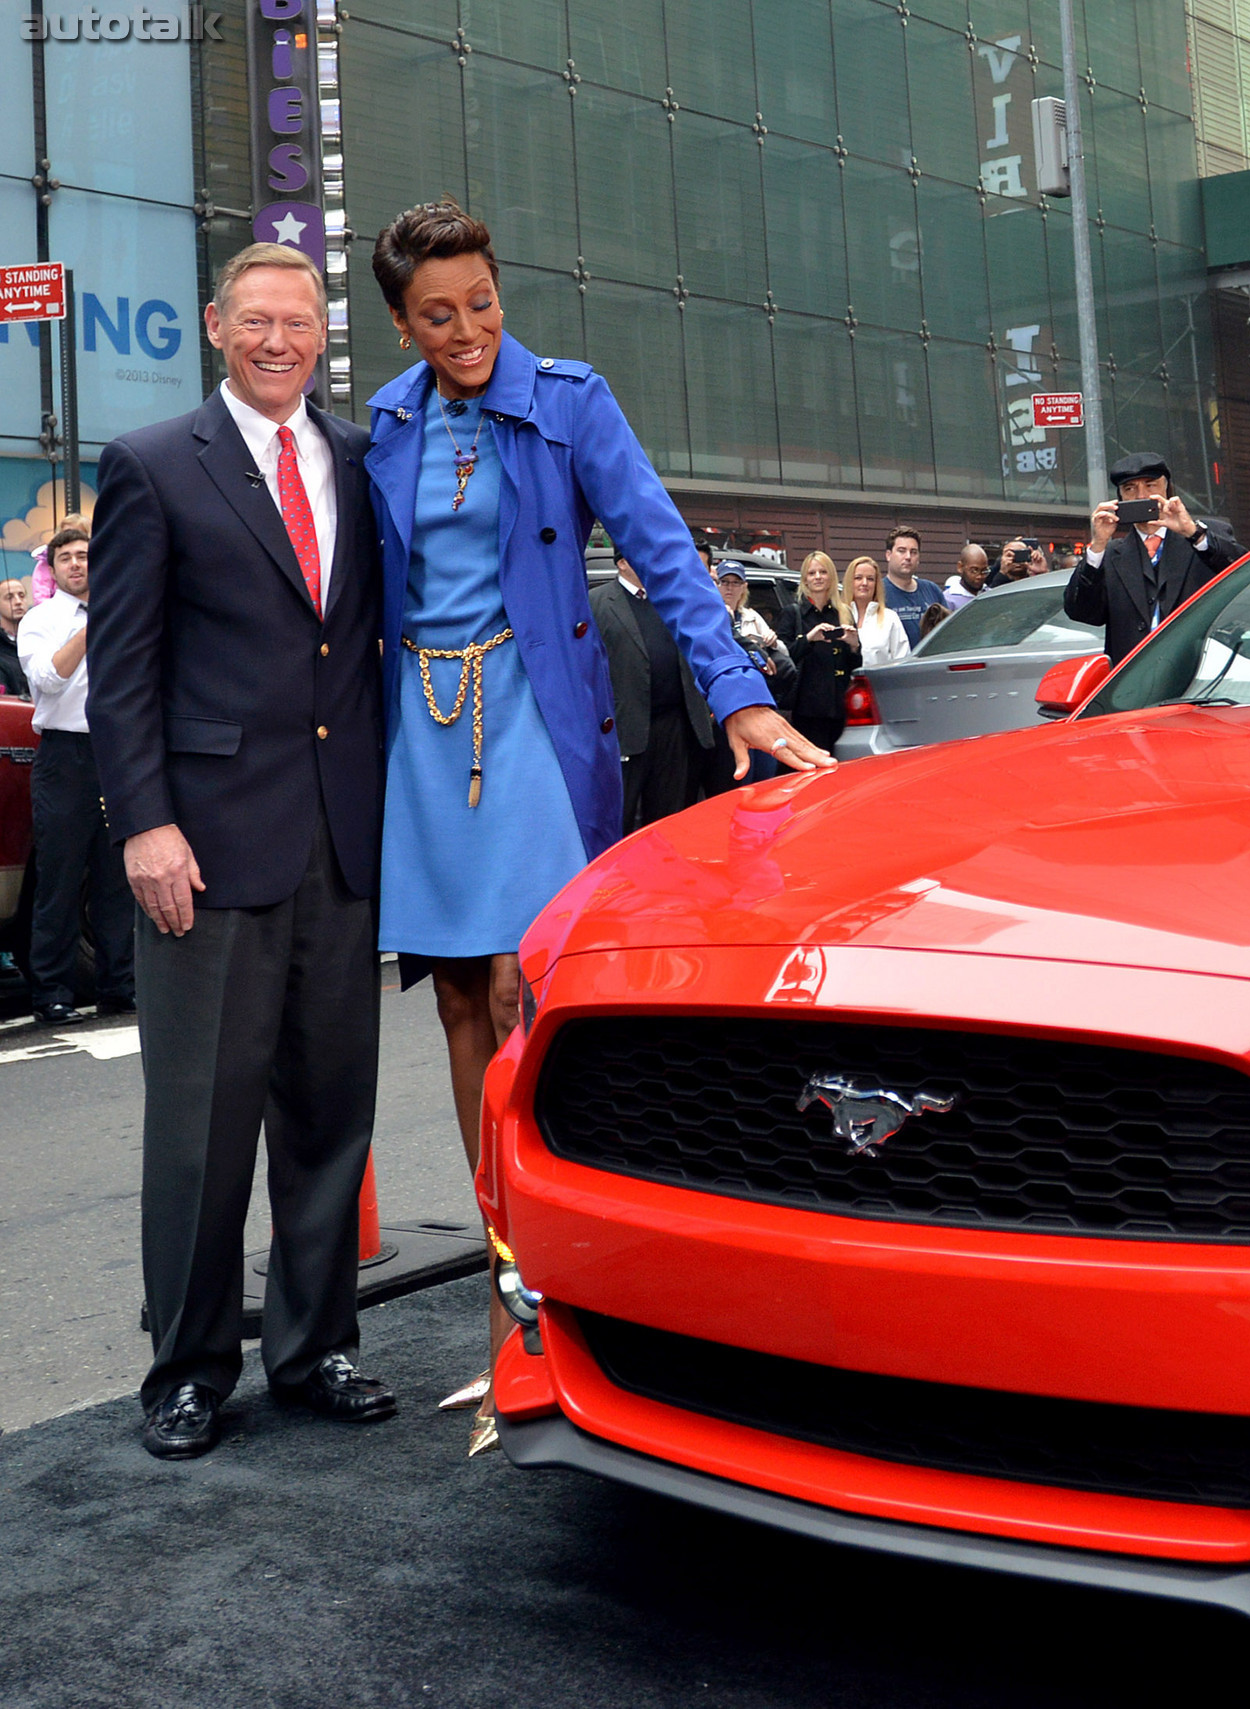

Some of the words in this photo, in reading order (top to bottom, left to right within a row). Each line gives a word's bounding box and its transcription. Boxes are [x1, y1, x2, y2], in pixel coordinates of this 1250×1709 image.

[5, 268, 58, 284] STANDING
[151, 371, 182, 389] Disney
[1035, 397, 1045, 405] NO
[1047, 396, 1078, 404] STANDING
[1041, 405, 1075, 413] ANYTIME
